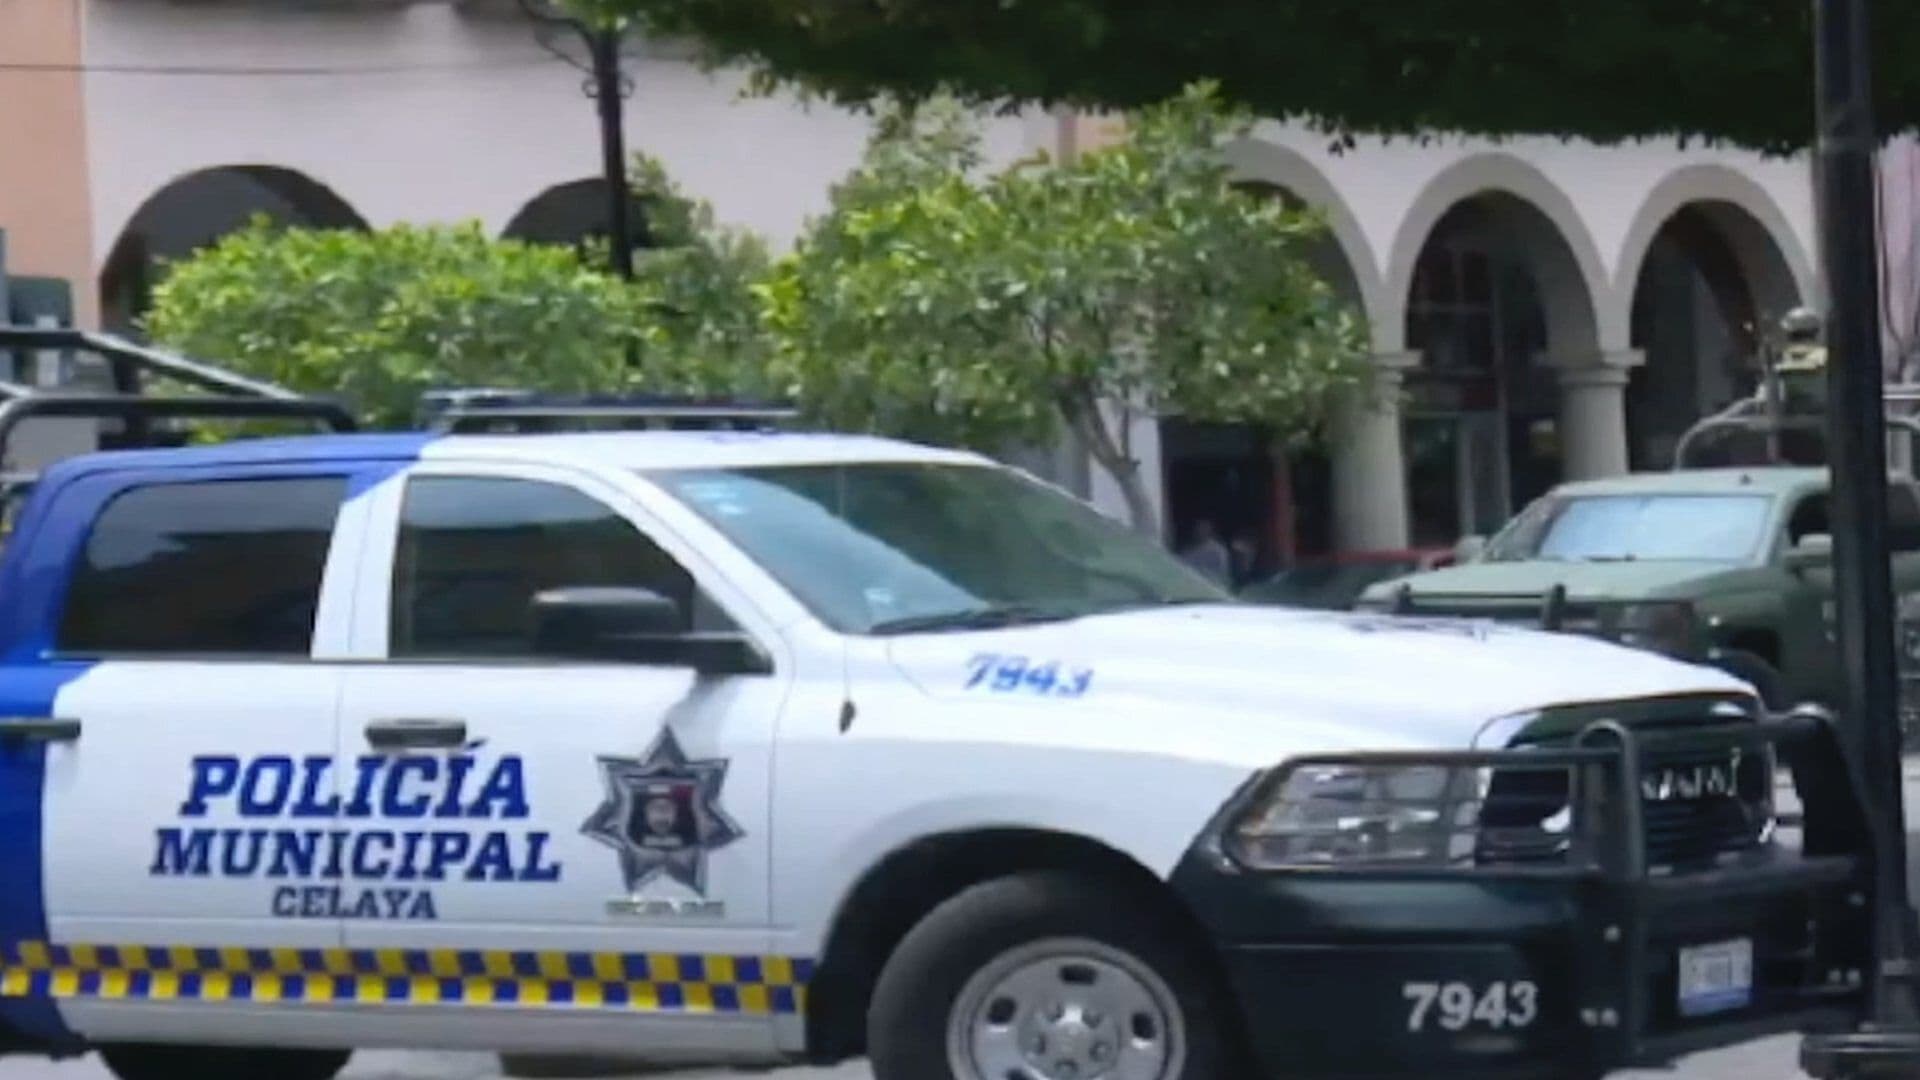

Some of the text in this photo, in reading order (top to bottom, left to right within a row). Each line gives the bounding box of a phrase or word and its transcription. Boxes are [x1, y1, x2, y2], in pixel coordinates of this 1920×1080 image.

[179, 737, 530, 818] POLICÍA
[149, 828, 561, 882] MUNICIPAL
[272, 886, 437, 920] CELAYA
[1402, 979, 1539, 1032] 7943
